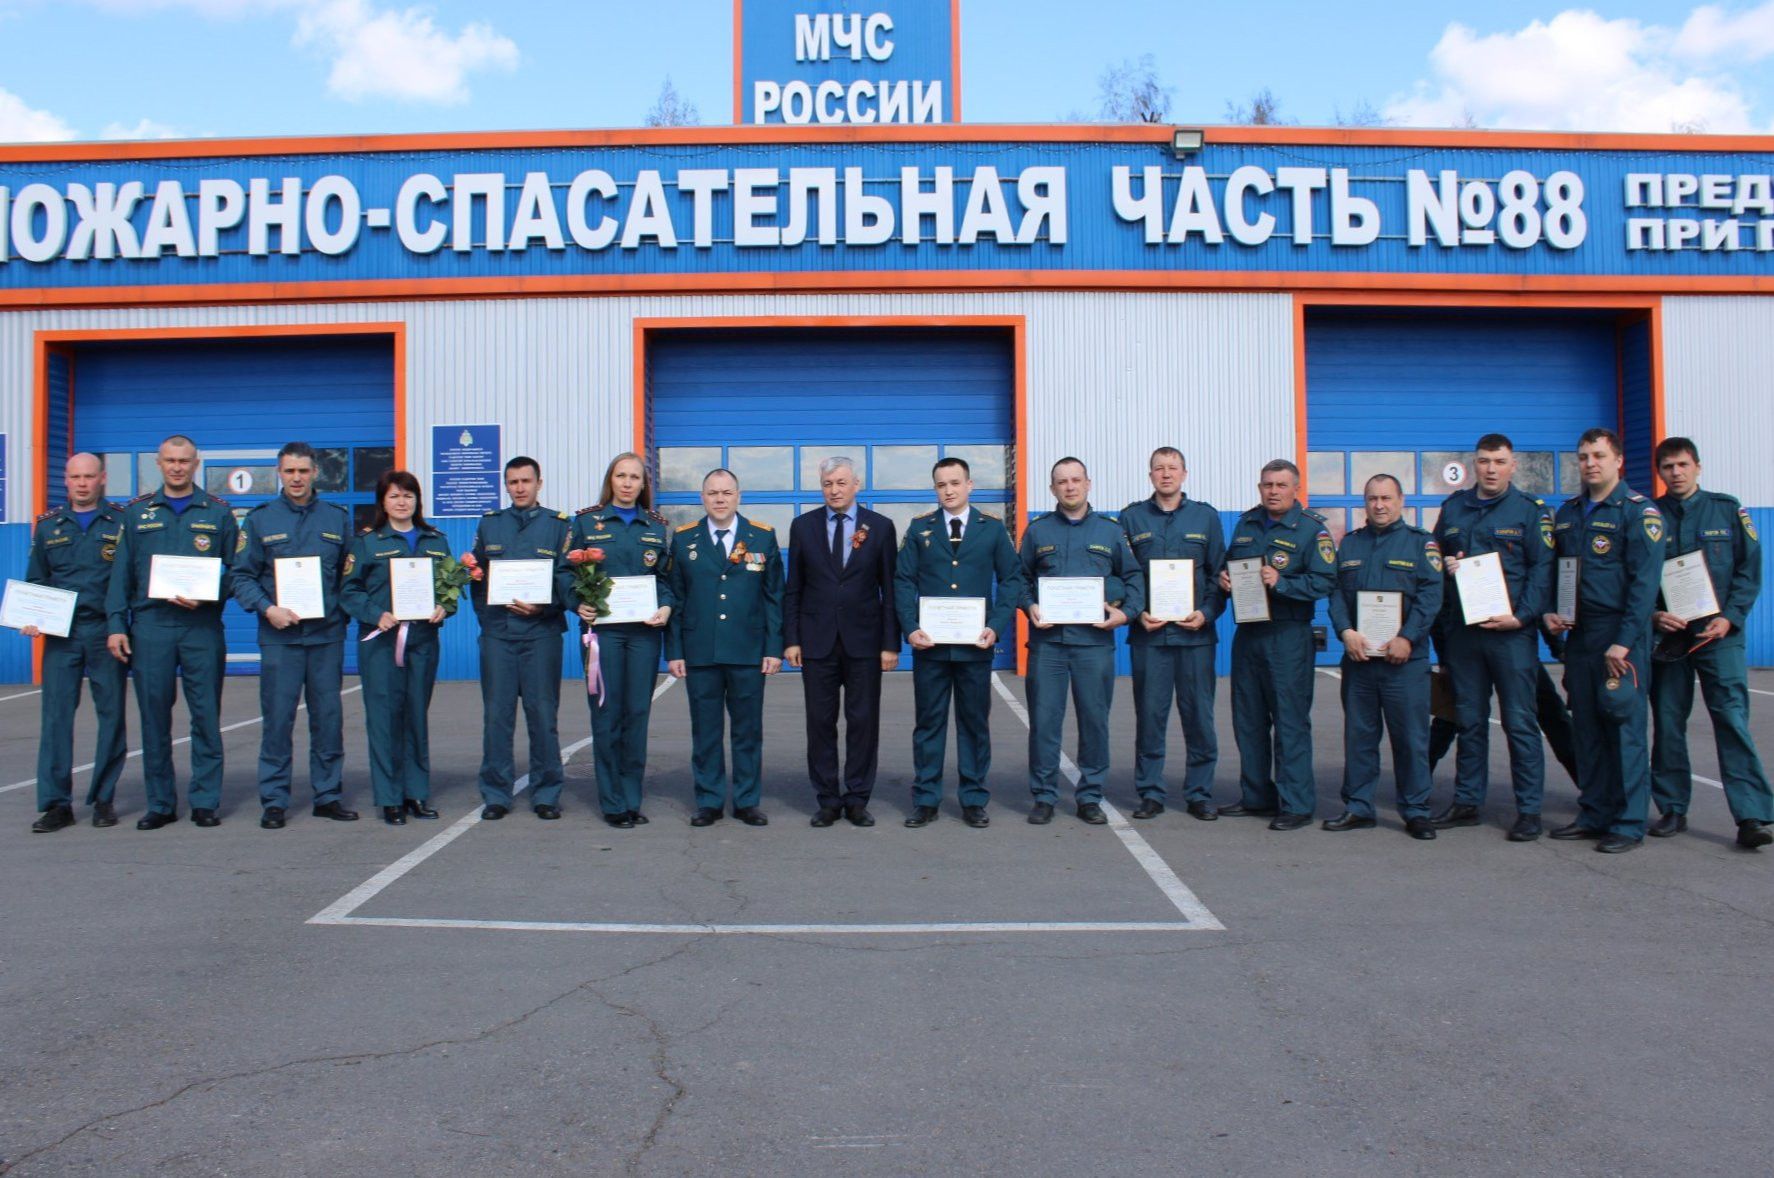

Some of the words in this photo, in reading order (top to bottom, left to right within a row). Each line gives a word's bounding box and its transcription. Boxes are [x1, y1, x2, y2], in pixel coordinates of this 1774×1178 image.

[794, 12, 895, 62] МЧС
[754, 79, 942, 124] РОССИИ
[0, 165, 1067, 263] ОЖАРНО-СПАСАТЕЛЬНАЯ
[1111, 164, 1381, 247] ЧАСТЬ
[1406, 169, 1588, 250] №88
[1626, 218, 1739, 251] ПРИ
[236, 473, 244, 489] 1
[1449, 467, 1458, 481] 3
